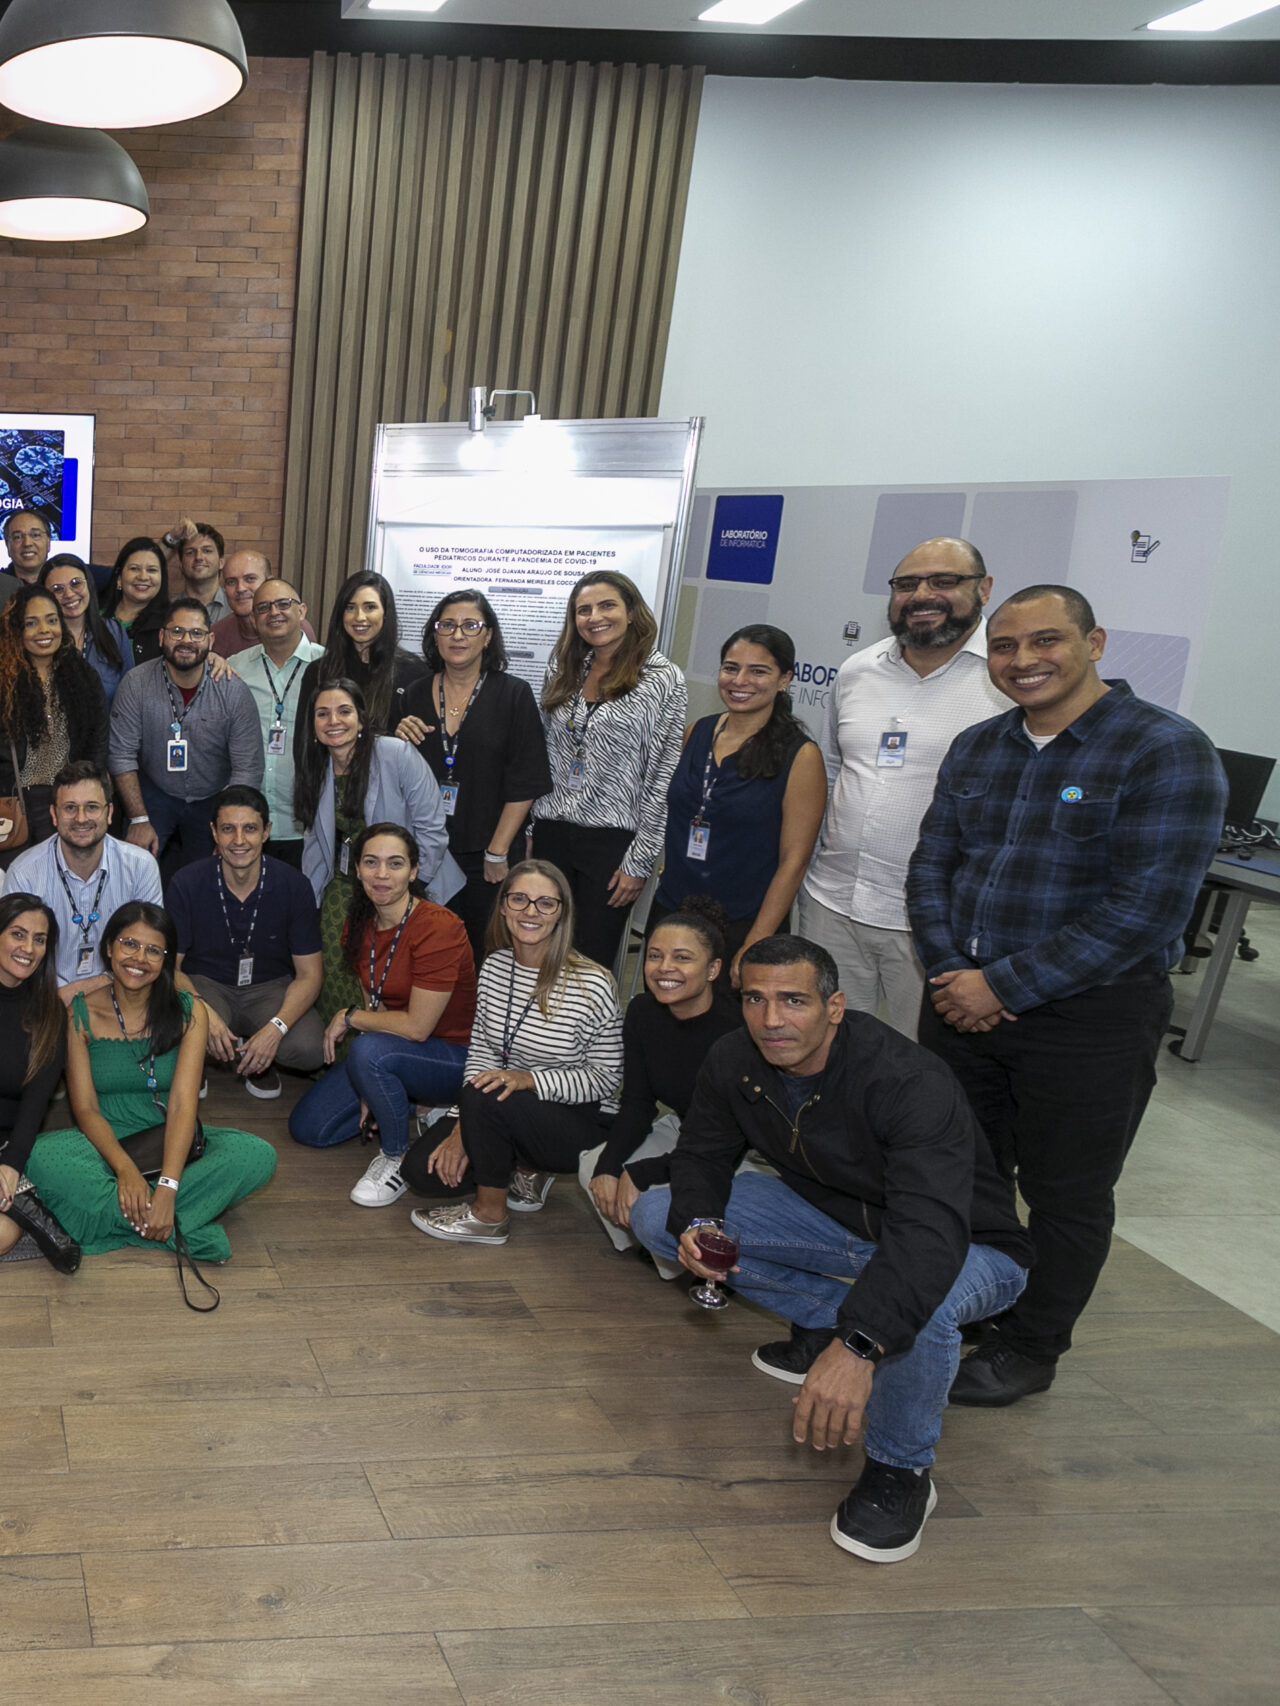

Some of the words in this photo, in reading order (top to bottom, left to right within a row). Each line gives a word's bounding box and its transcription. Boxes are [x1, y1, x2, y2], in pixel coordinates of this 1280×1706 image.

[721, 529, 768, 540] LABORATÓRIO
[720, 539, 728, 547] DE
[495, 548, 562, 556] COMPUTADORIZADA
